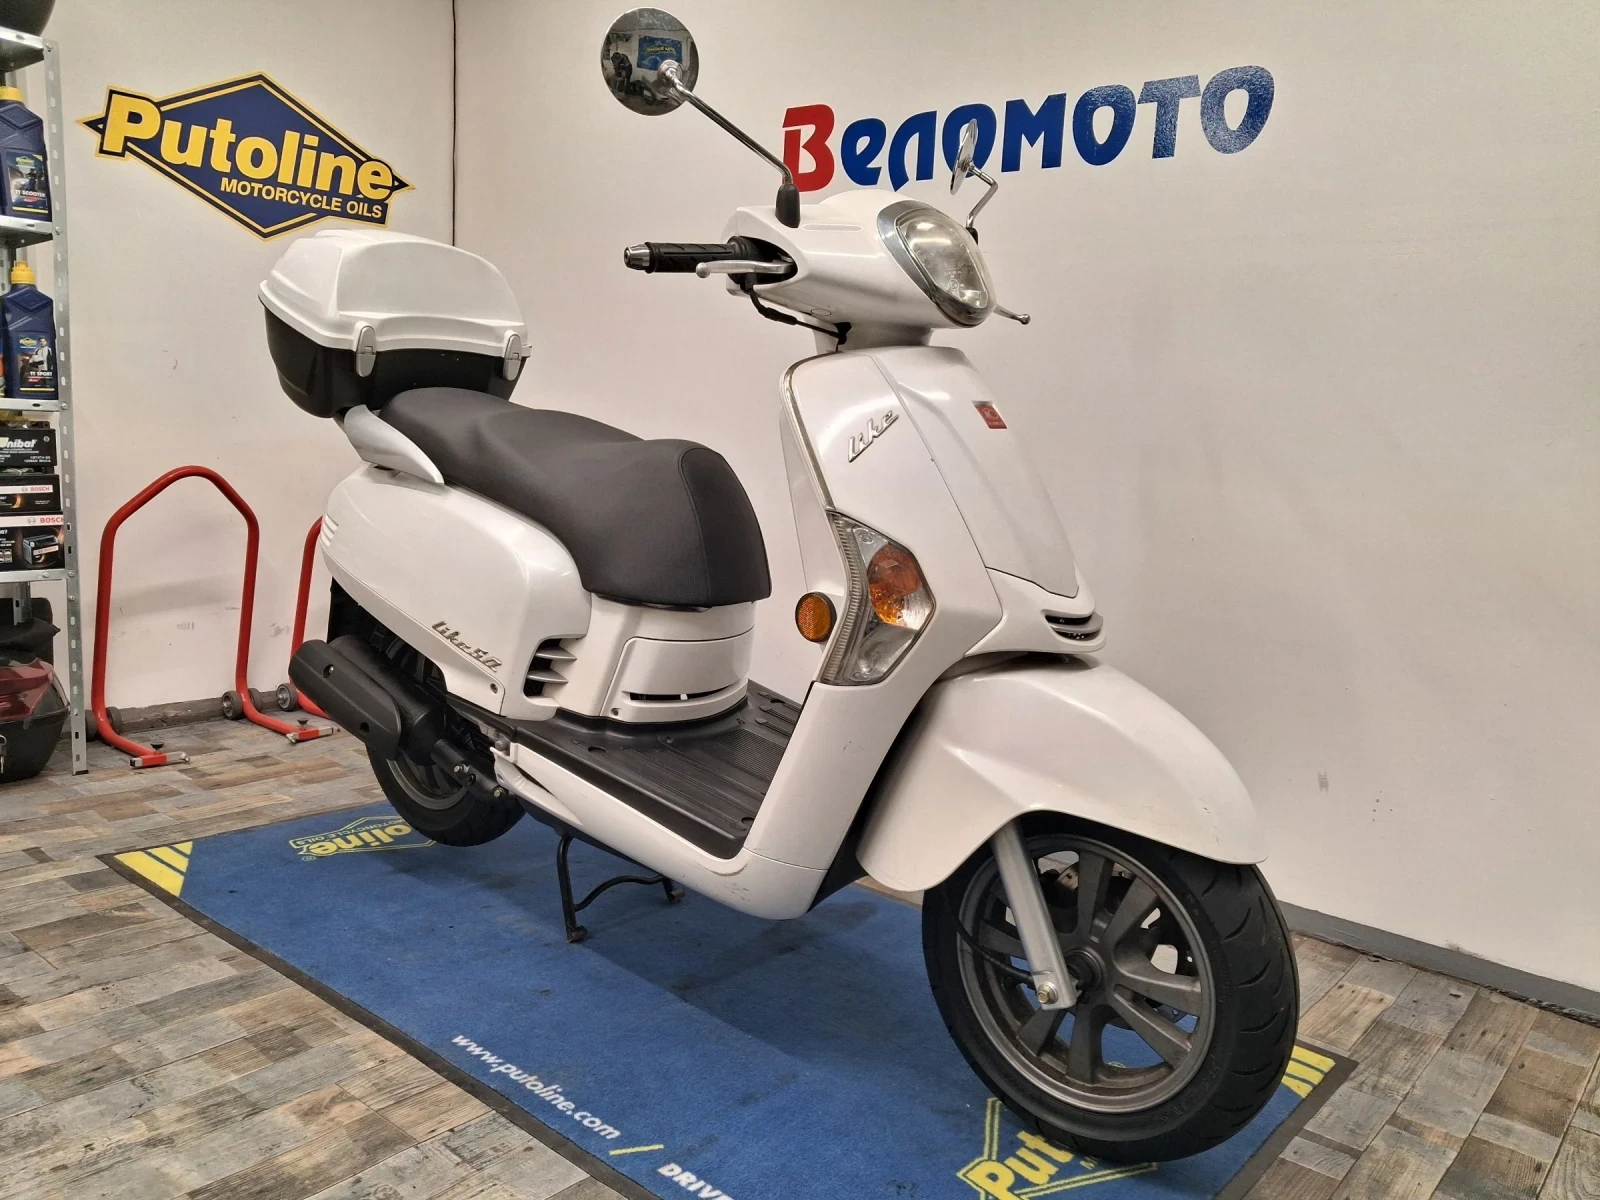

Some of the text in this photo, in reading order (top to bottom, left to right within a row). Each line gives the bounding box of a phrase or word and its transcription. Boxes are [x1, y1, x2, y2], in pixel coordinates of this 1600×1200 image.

[102, 93, 393, 200] Putoline
[220, 177, 383, 218] MOTORCYCLE OILS
[451, 1034, 621, 1140] www.putoline.com
